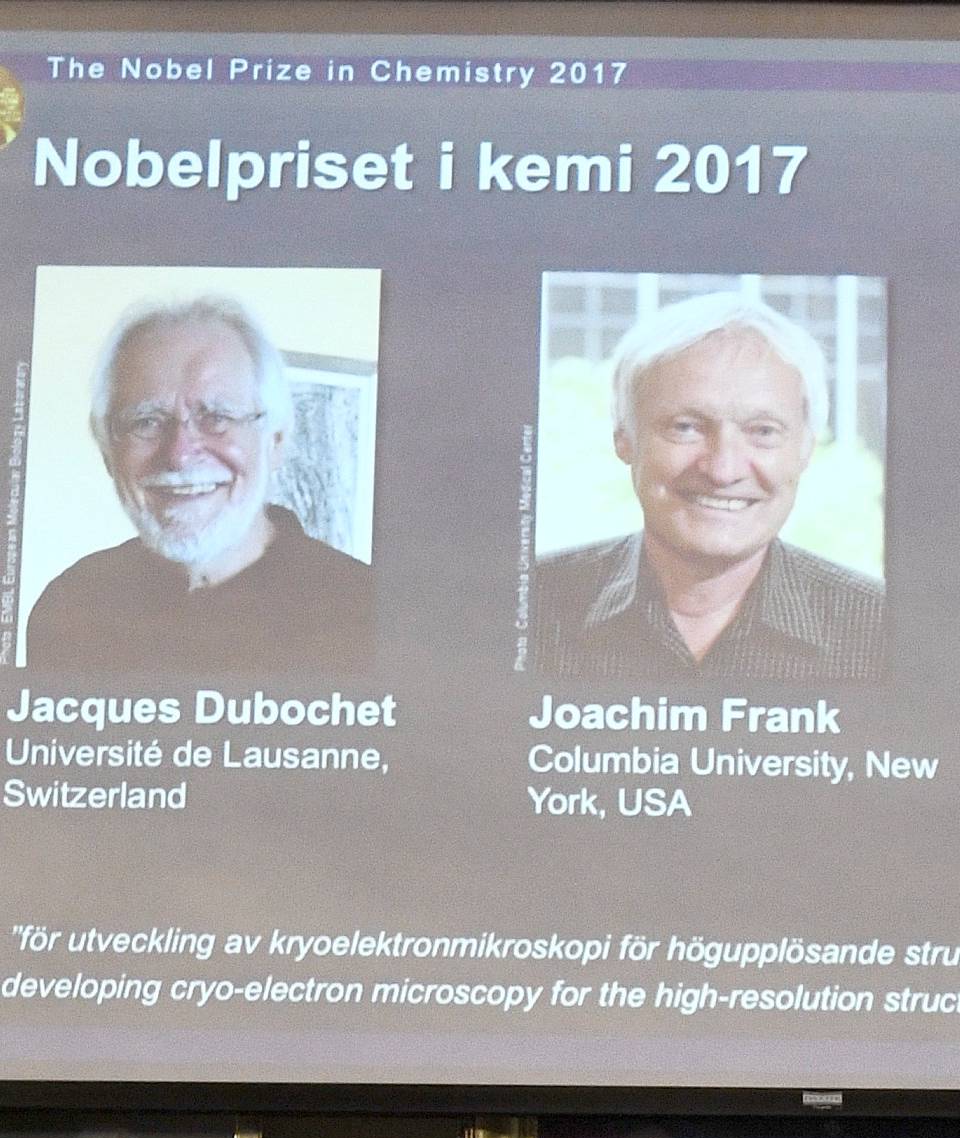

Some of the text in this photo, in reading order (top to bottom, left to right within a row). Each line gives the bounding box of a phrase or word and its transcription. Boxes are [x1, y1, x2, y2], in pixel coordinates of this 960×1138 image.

[48, 57, 626, 89] The Nobel Prize in Chemistry 2017
[35, 138, 807, 200] Nobelpriset i kemi 2017
[7, 689, 396, 731] Jacques Dubochet
[529, 695, 840, 733] Joachim Frank
[7, 739, 388, 773] Université de Lausanne,
[529, 745, 938, 784] Columbia University, New
[4, 779, 186, 808] Switzerland
[528, 787, 691, 818] York, USA
[69, 928, 215, 959] utveckling
[225, 935, 261, 954] av
[269, 929, 611, 965] kryoelektronmikroskopi
[620, 935, 660, 960] för
[667, 936, 895, 968] högupplösande
[2, 972, 161, 1006] developing
[171, 976, 362, 1006] cryo-electron
[372, 978, 543, 1012] microscopy
[551, 980, 592, 1006] for
[599, 982, 646, 1007] the
[655, 982, 873, 1014] high-resolution
